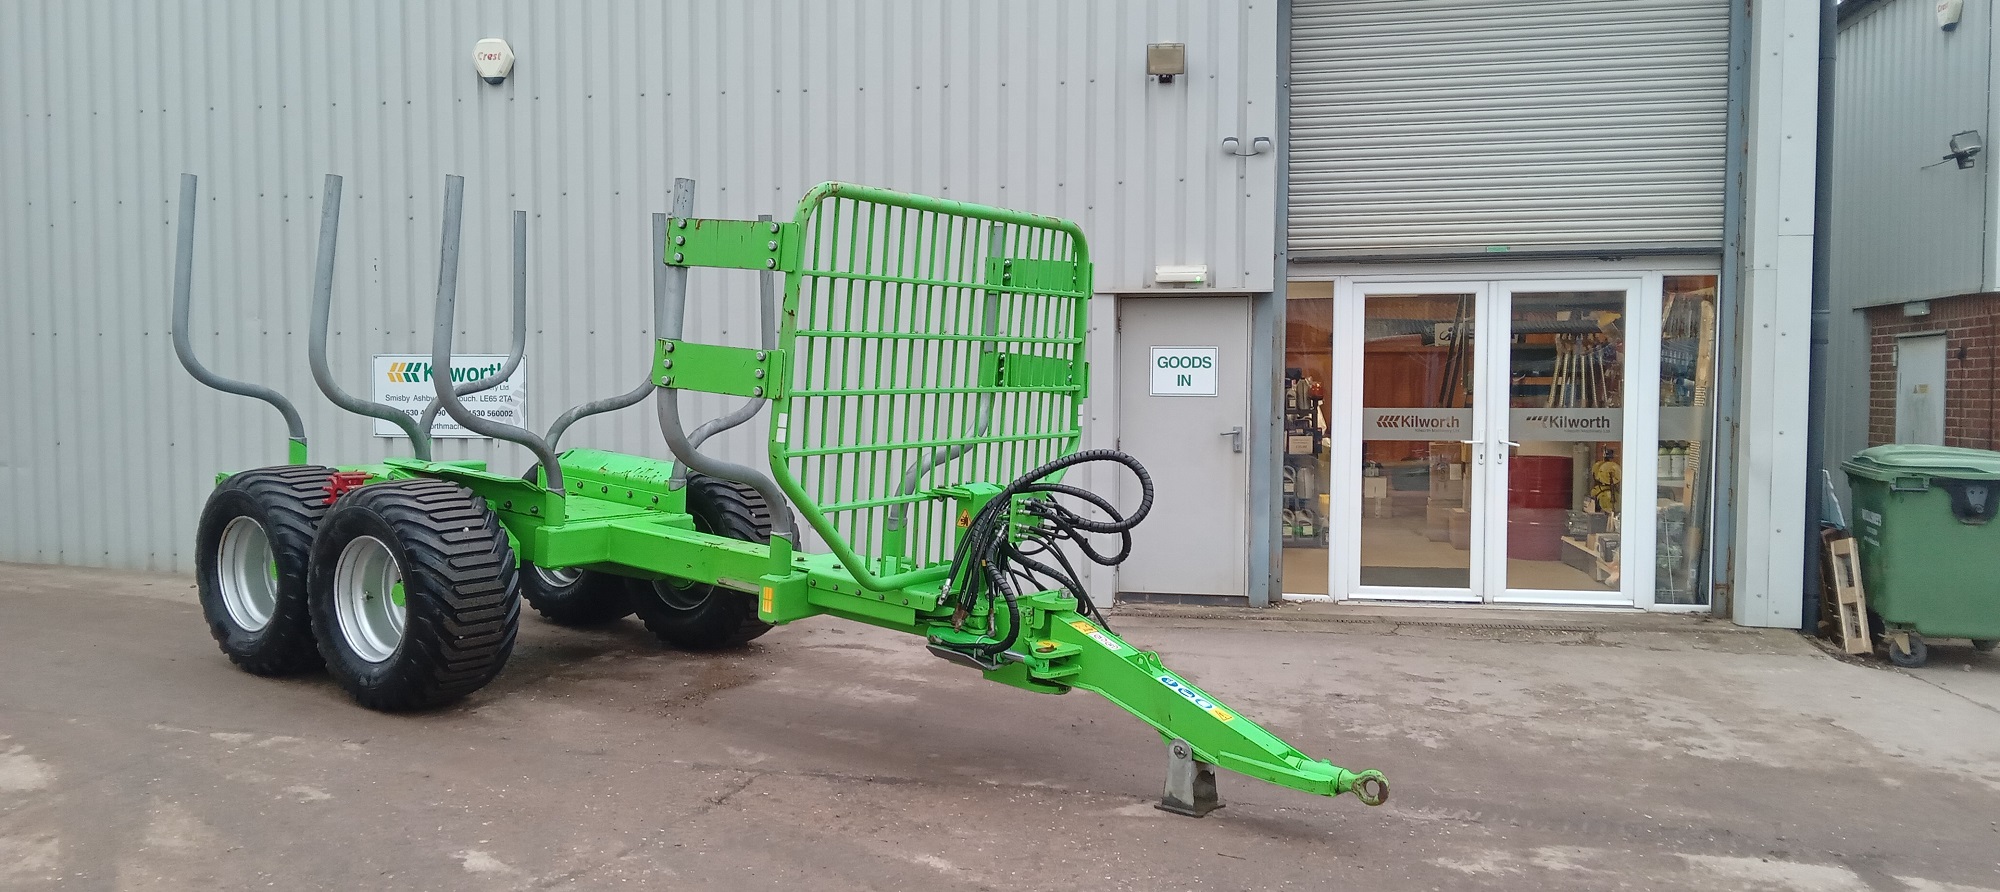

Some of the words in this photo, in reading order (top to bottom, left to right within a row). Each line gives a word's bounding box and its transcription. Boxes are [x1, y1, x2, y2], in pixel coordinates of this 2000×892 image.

[477, 51, 502, 61] Crest
[1157, 356, 1212, 369] GOODS
[424, 362, 509, 382] Kwort
[1177, 374, 1192, 387] IN
[385, 394, 411, 404] Smisby
[480, 395, 498, 403] LE65
[499, 394, 513, 403] 2TA
[487, 409, 513, 417] 560002
[1401, 415, 1460, 428] Kilworth
[1549, 415, 1610, 428] Kilworth
